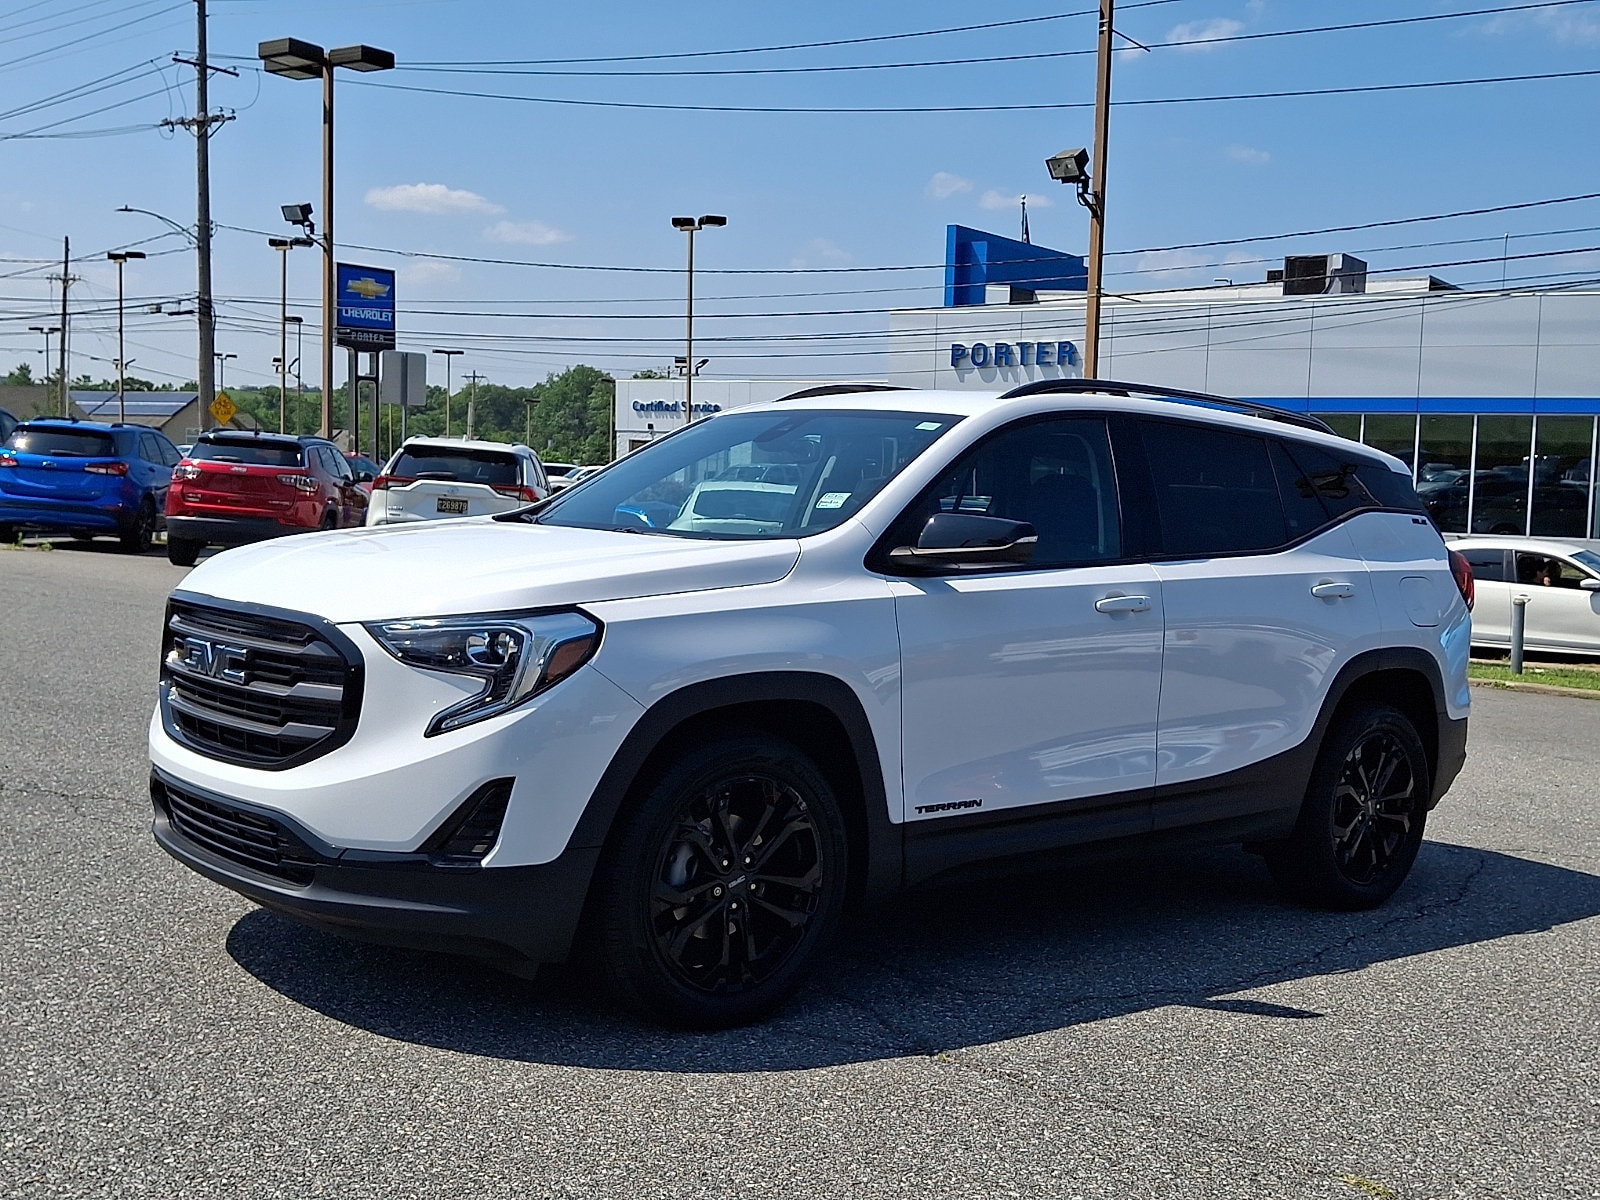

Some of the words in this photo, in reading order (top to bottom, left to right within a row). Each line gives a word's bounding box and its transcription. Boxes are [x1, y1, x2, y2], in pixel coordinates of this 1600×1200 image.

[342, 308, 393, 322] CHEVROLET
[351, 331, 385, 342] PORTER
[950, 341, 1076, 367] PORTER
[632, 400, 678, 412] Certified
[183, 637, 247, 684] GMC
[915, 799, 983, 814] TERRAIN
